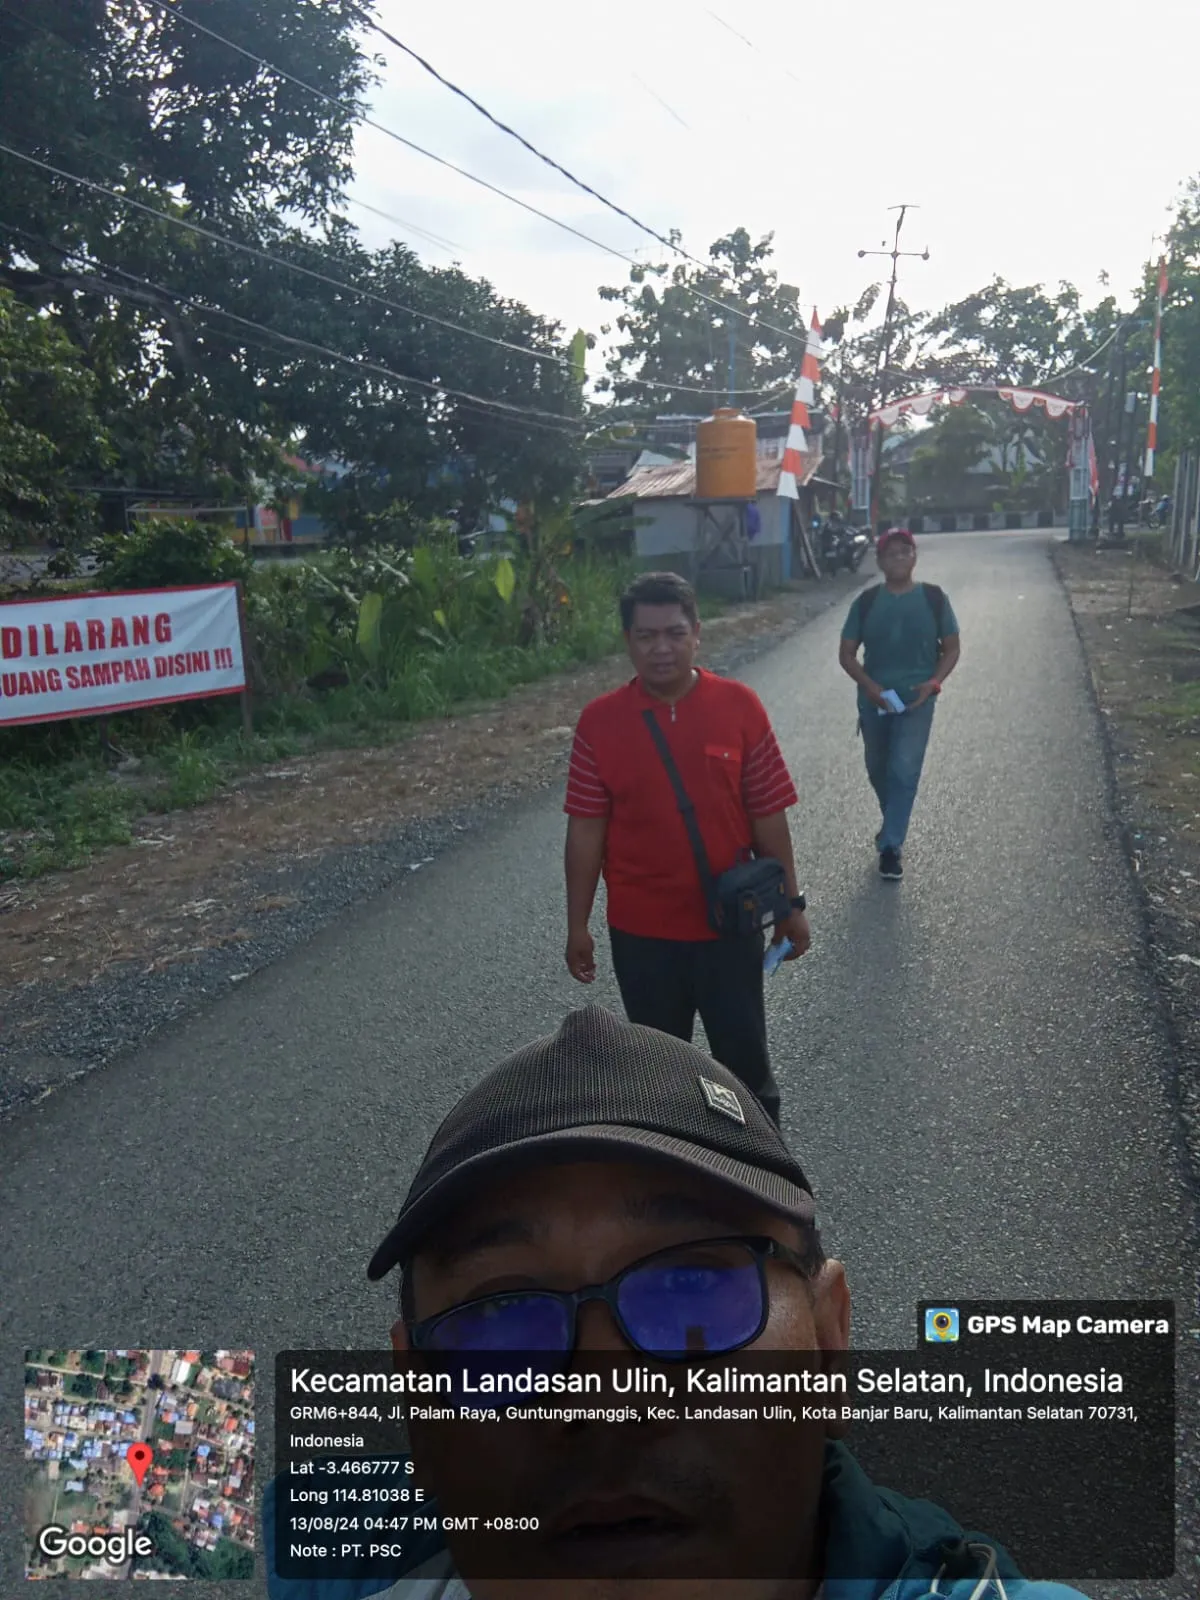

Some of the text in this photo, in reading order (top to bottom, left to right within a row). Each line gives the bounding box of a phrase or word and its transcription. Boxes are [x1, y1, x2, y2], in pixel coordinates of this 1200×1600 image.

[2, 613, 172, 659] DILARANG
[0, 648, 233, 697] UANG SAMPAH DISINI !!!
